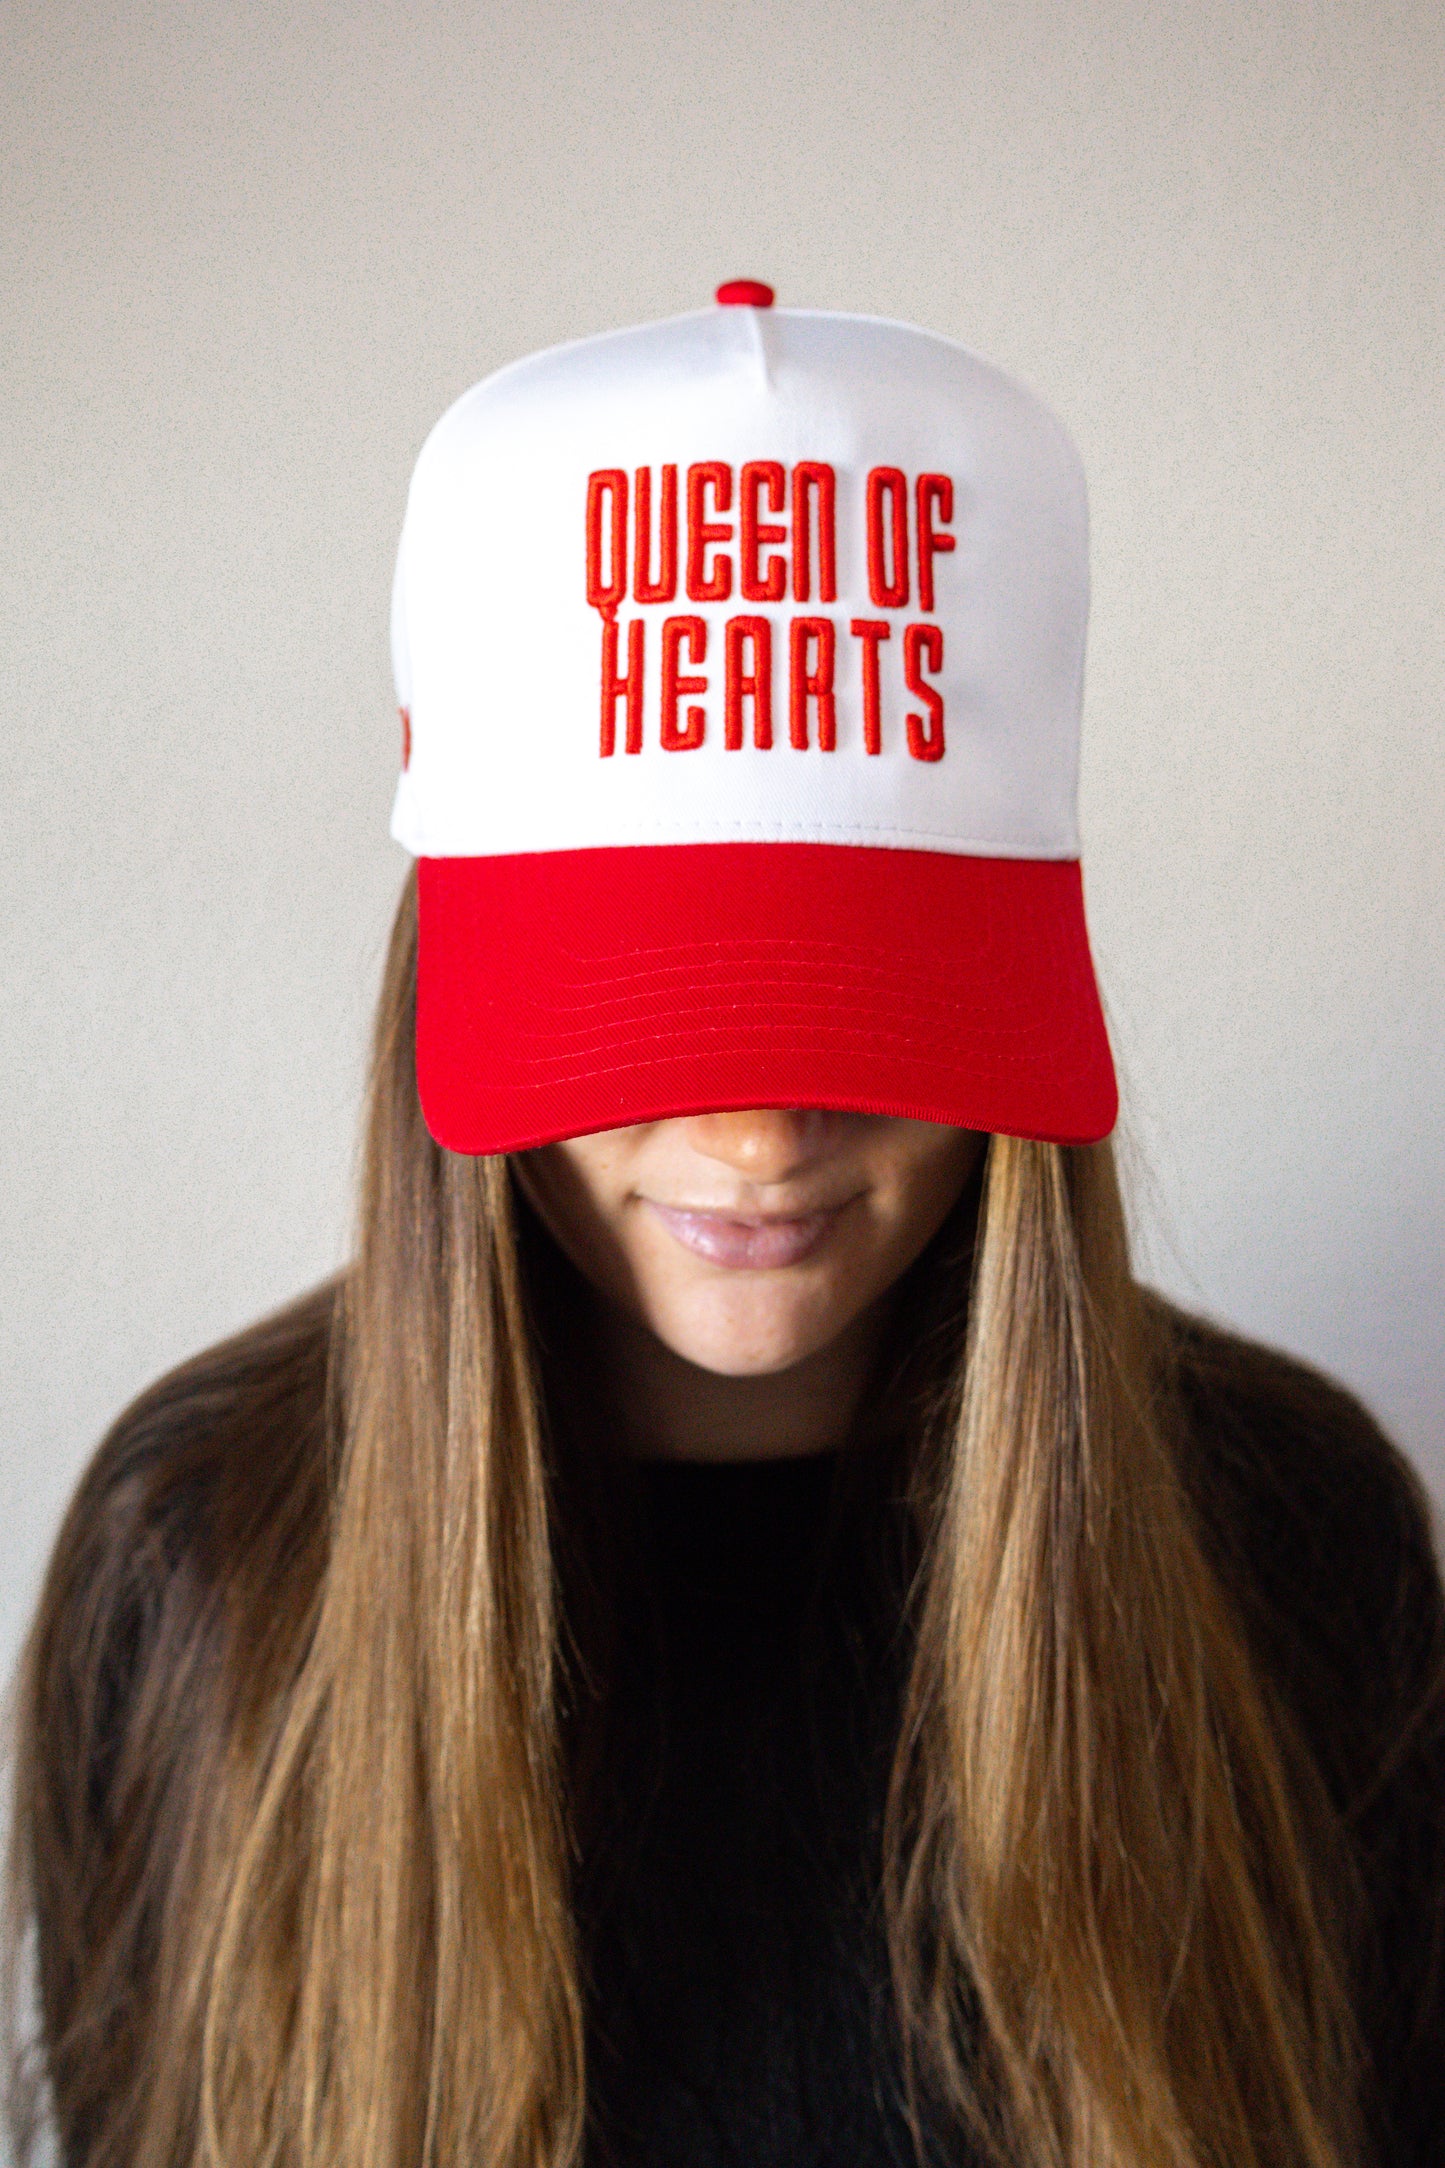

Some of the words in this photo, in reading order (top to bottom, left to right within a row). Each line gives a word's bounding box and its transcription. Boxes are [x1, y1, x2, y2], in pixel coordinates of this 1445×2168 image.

[586, 459, 838, 620] QUEEN
[866, 465, 956, 613] OF
[599, 615, 946, 763] HEARTS
